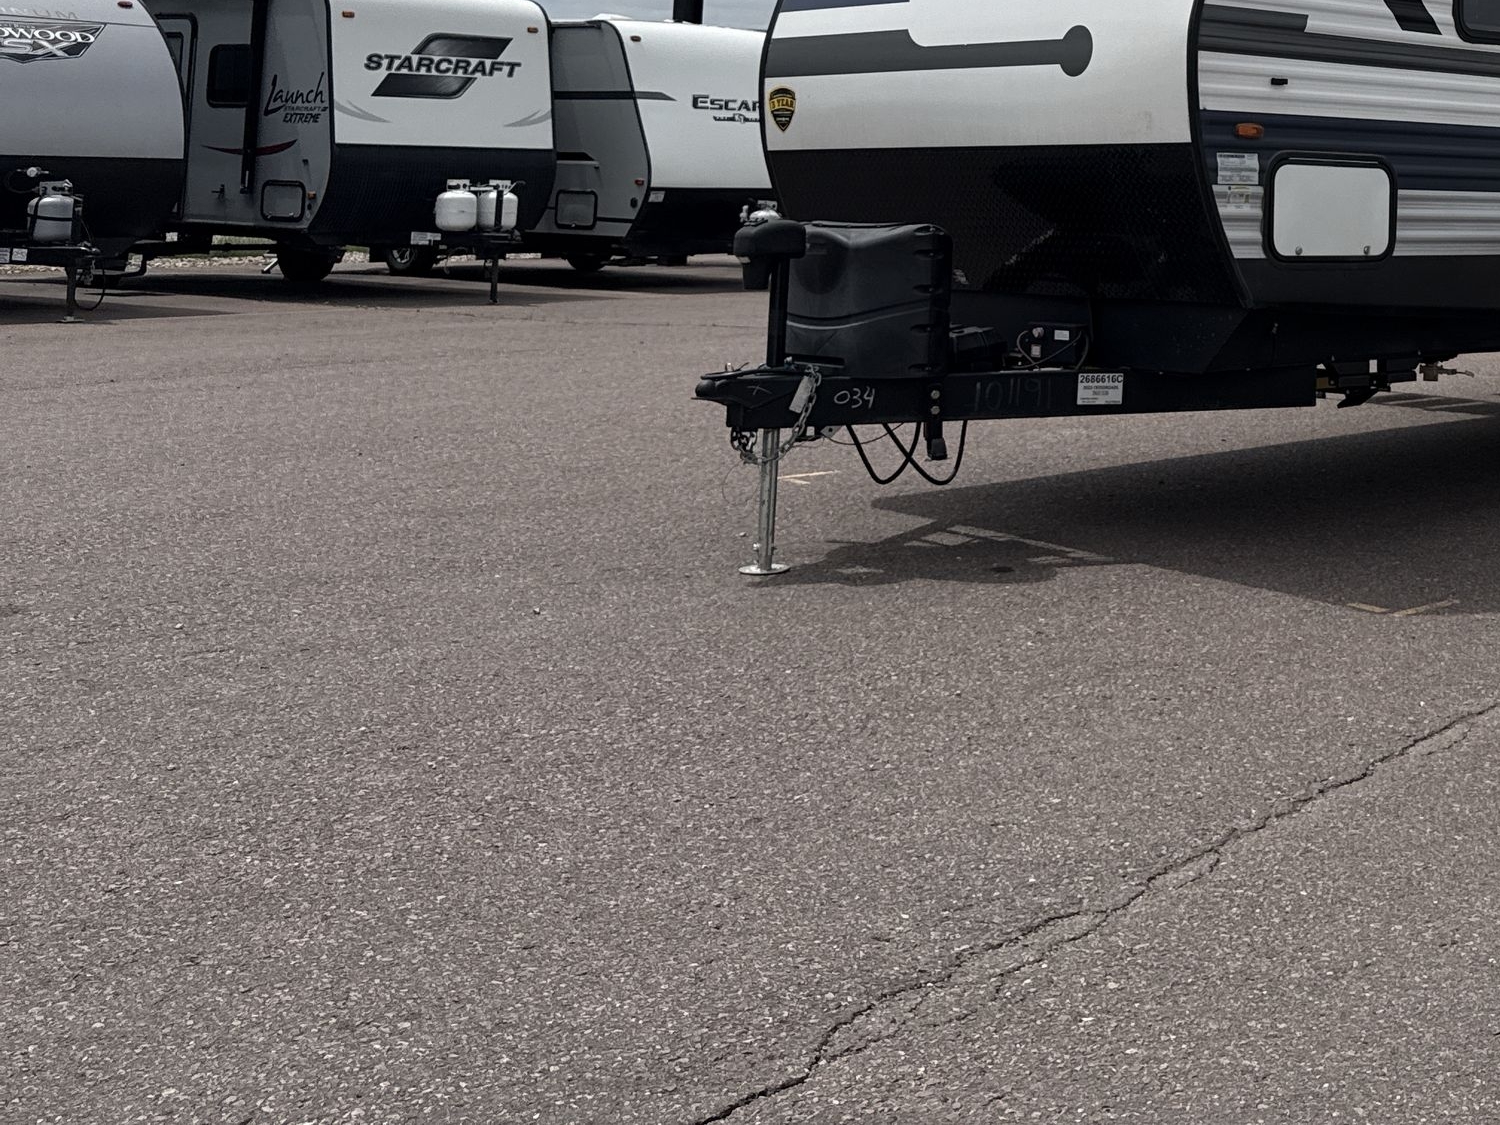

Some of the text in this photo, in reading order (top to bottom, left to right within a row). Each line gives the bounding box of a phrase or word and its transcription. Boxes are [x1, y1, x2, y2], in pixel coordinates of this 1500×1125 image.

[364, 53, 522, 78] STARCRAFT
[263, 71, 325, 117] Launch
[777, 98, 794, 109] YEAR
[282, 112, 321, 124] EXTREME
[833, 386, 876, 409] 034
